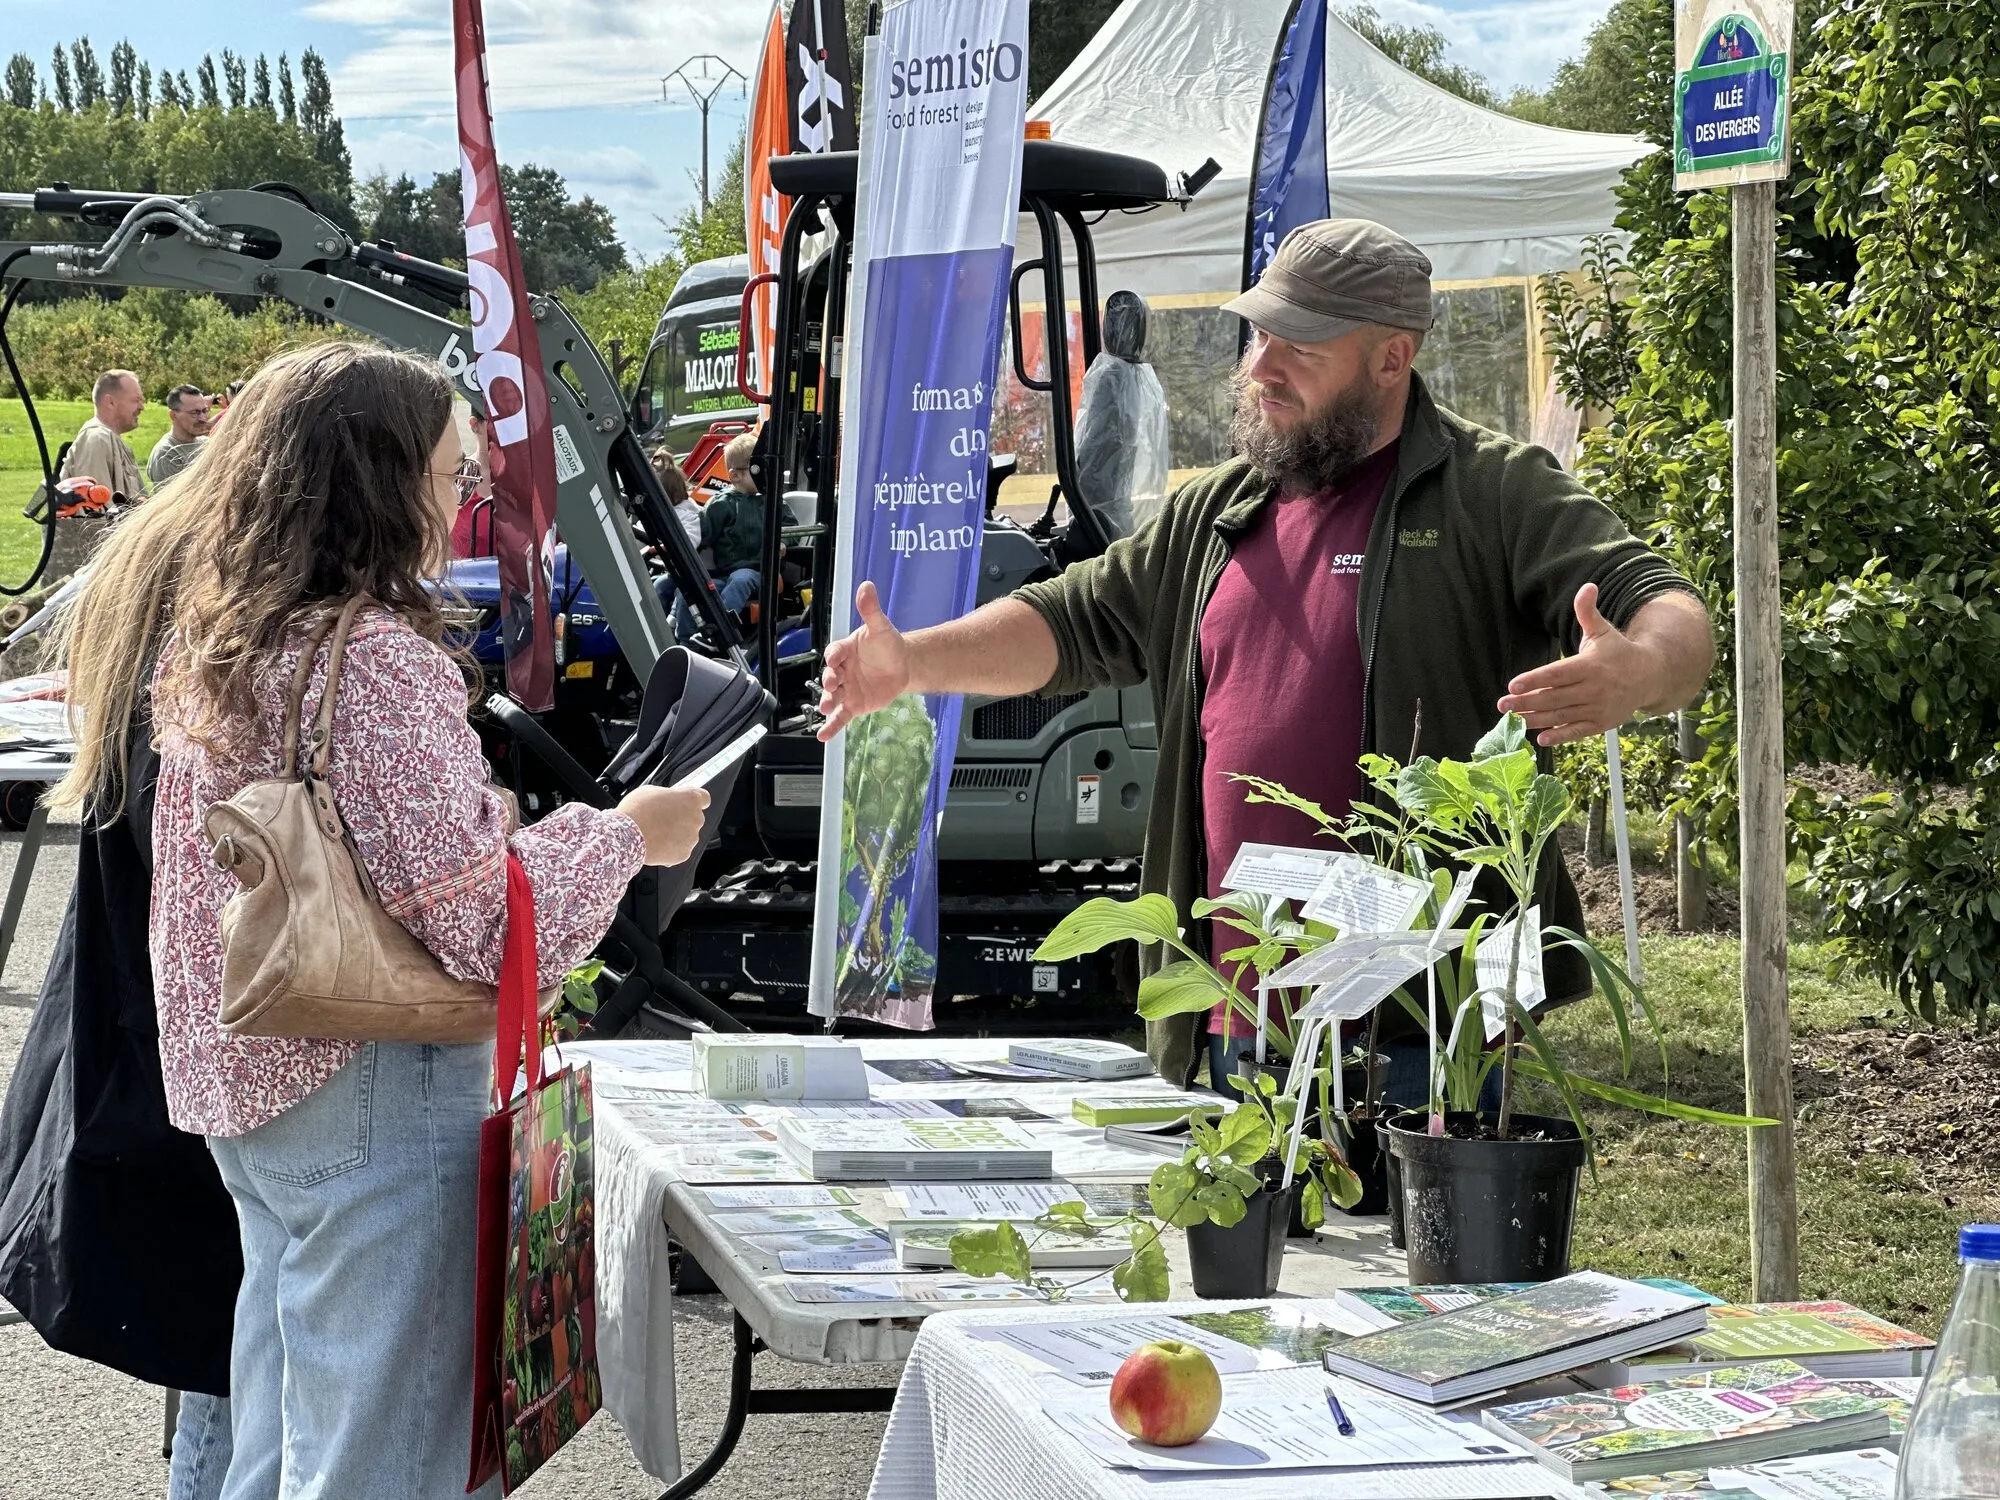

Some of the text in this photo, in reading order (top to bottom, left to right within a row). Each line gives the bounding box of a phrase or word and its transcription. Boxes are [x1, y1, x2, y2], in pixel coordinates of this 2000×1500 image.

[890, 38, 1023, 99] semisto
[1714, 85, 1743, 110] ALLÉE
[886, 103, 959, 130] food forest
[1696, 115, 1760, 143] DES VERGERS
[554, 430, 578, 473] MALOTAUX
[1399, 528, 1438, 547] Jack Wolfskin
[1672, 1390, 1745, 1425] POTAGER
